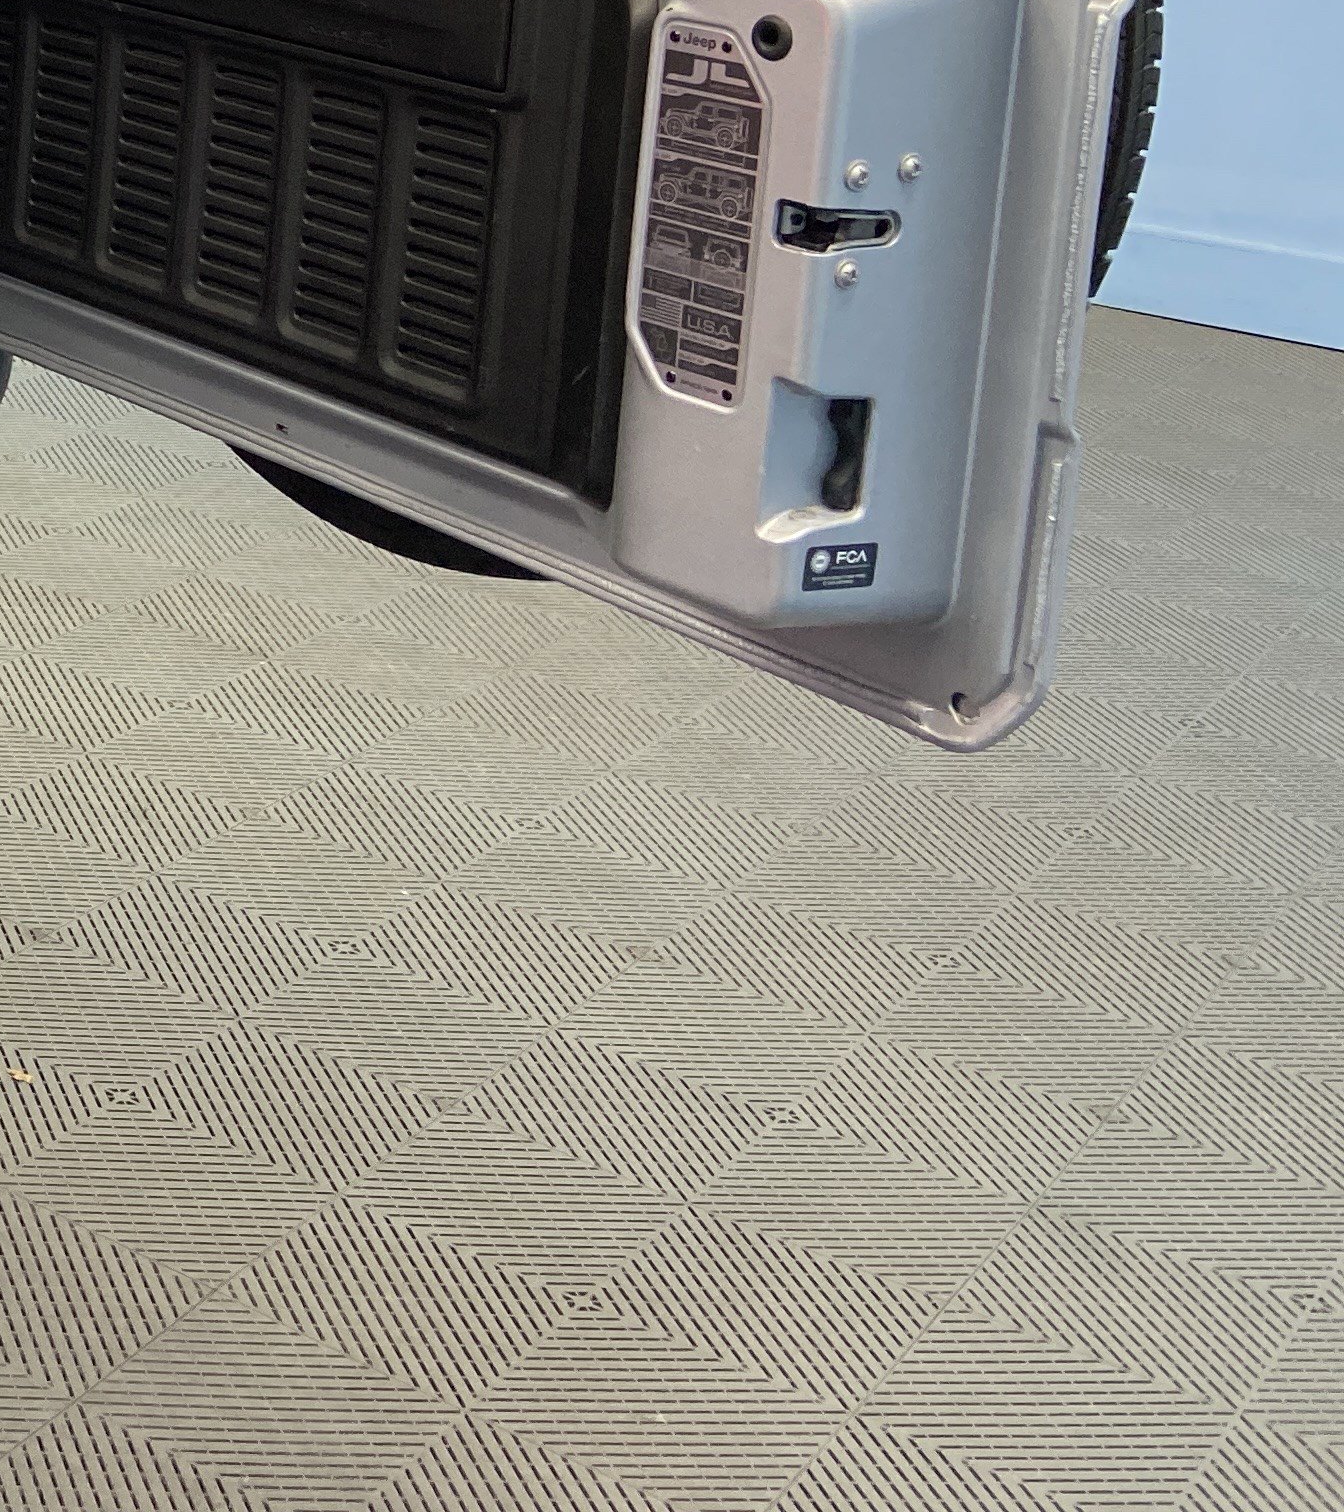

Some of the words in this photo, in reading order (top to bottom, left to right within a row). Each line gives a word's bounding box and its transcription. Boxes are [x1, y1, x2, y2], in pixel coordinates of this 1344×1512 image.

[683, 32, 717, 51] Jeep
[665, 58, 750, 88] JL
[836, 549, 867, 564] FCA
